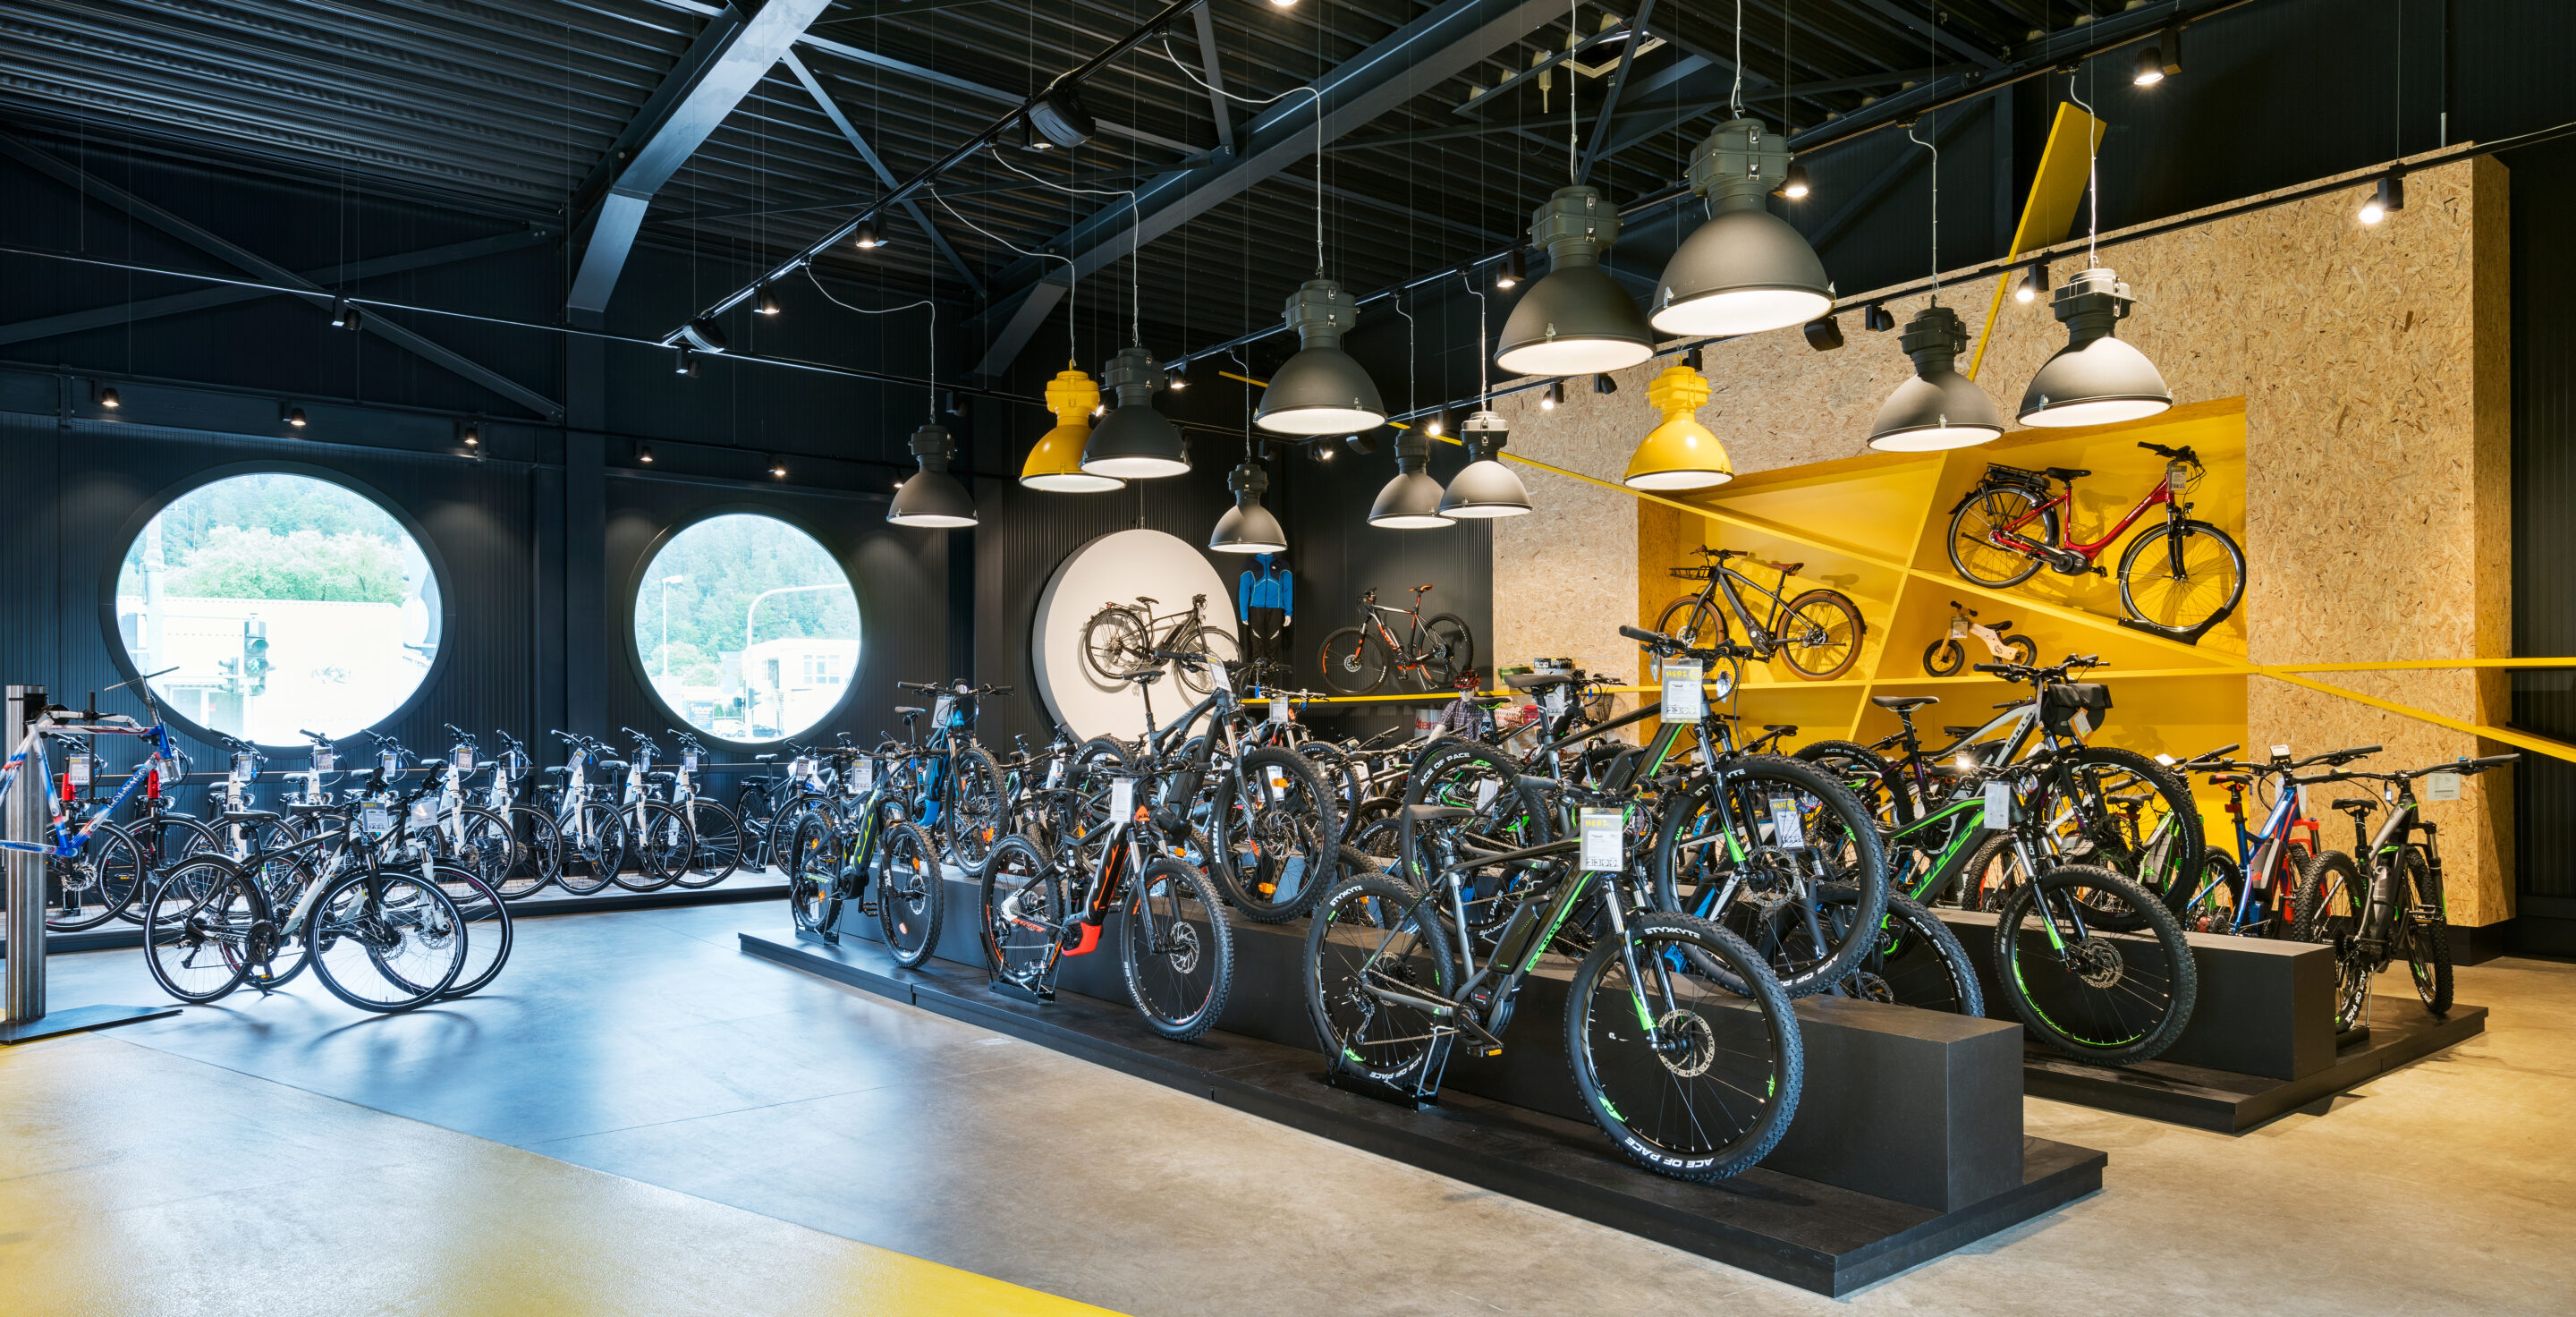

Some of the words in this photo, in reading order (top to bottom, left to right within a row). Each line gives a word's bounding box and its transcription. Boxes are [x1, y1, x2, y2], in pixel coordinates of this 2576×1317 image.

[2007, 712, 2033, 749] BULLS
[1074, 746, 1093, 766] MAXXIS
[1420, 768, 1435, 786] ACE
[1433, 759, 1445, 769] OF
[1446, 752, 1470, 762] PACE
[106, 769, 148, 809] COLNAGO
[1212, 820, 1222, 863] MAXXIS
[1586, 859, 1617, 867] 2399
[1818, 953, 1839, 974] ACE
[1908, 916, 1932, 936] ACE
[1933, 939, 1946, 956] OF
[1946, 960, 1962, 998] PACE
[1796, 972, 1814, 983] OF
[1123, 961, 1151, 1017] SCHWALBE
[1409, 1052, 1423, 1071] ACE
[1395, 1068, 1408, 1078] OF
[1624, 1136, 1661, 1162] PACE
[1663, 1159, 1682, 1168] OF
[1685, 1158, 1715, 1168] ACE
